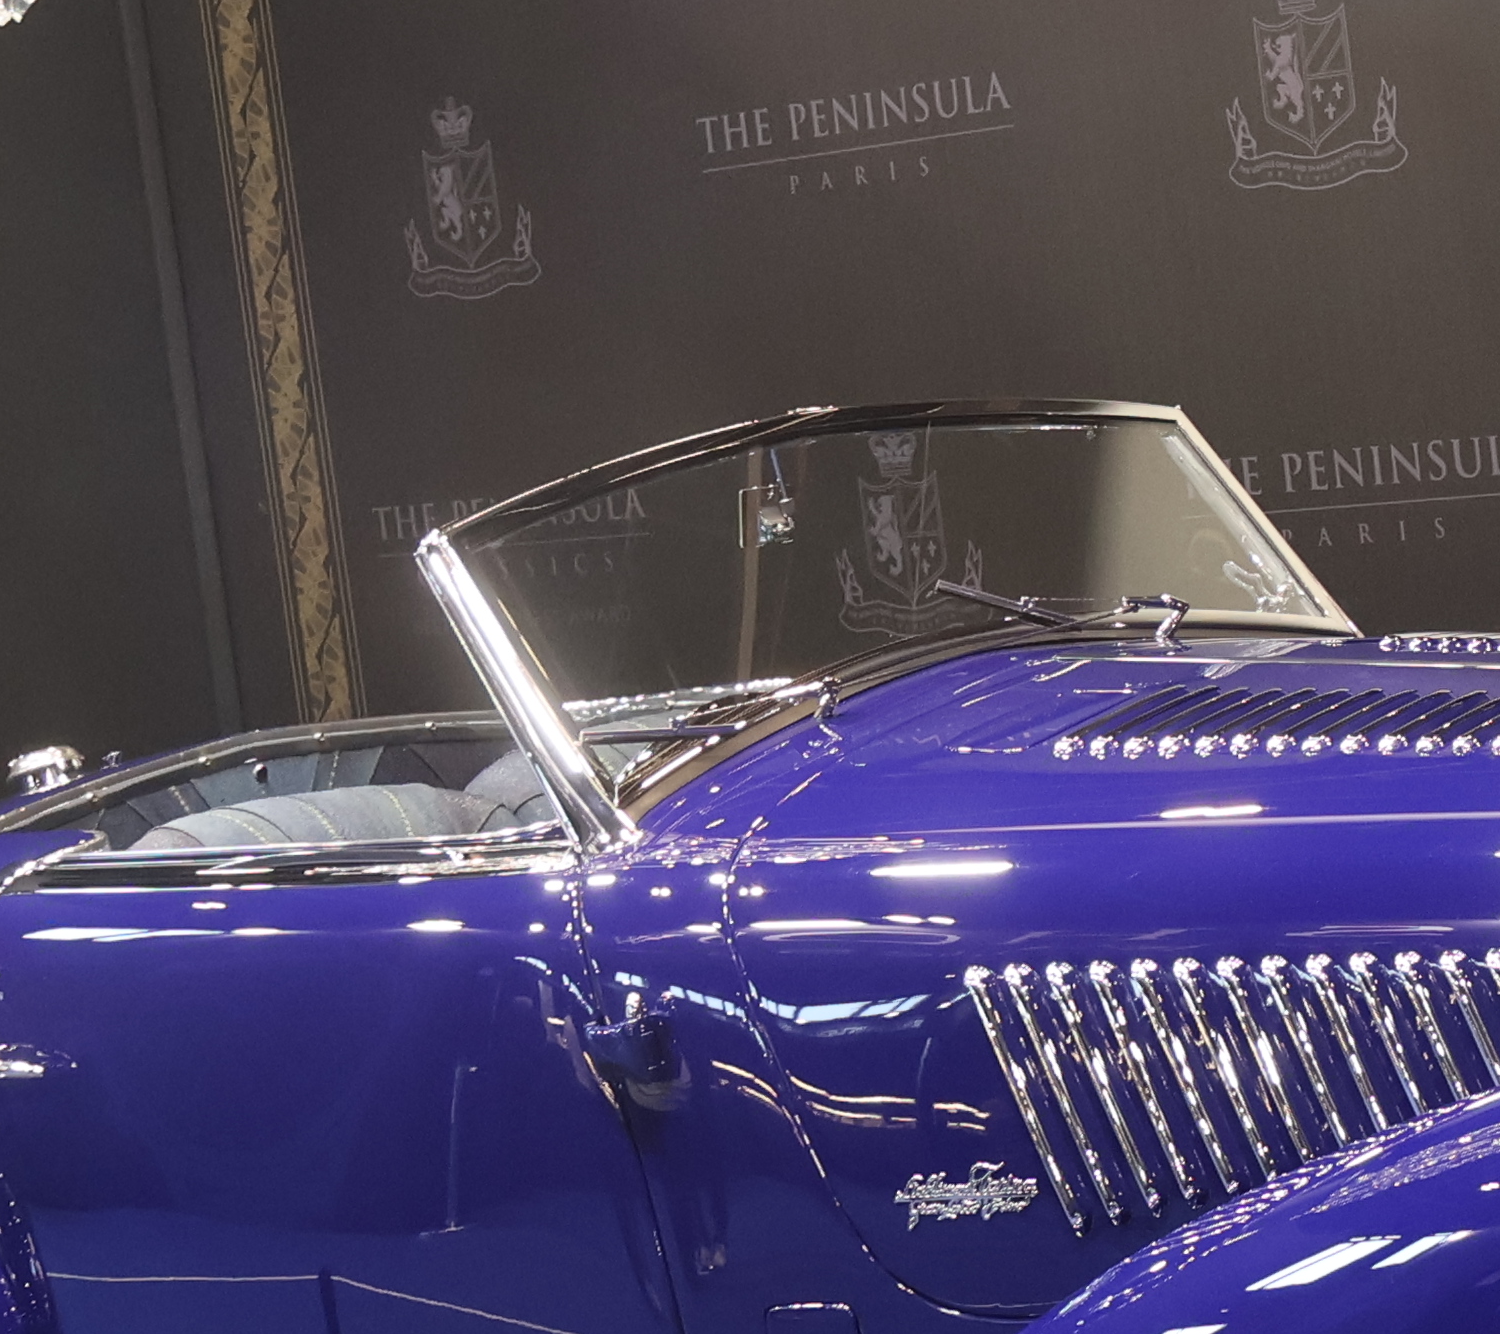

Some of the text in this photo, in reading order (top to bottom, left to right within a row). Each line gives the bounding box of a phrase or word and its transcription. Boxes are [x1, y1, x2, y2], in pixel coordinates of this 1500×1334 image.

[696, 70, 1012, 154] THE PENINSULA
[789, 155, 930, 195] PARIS
